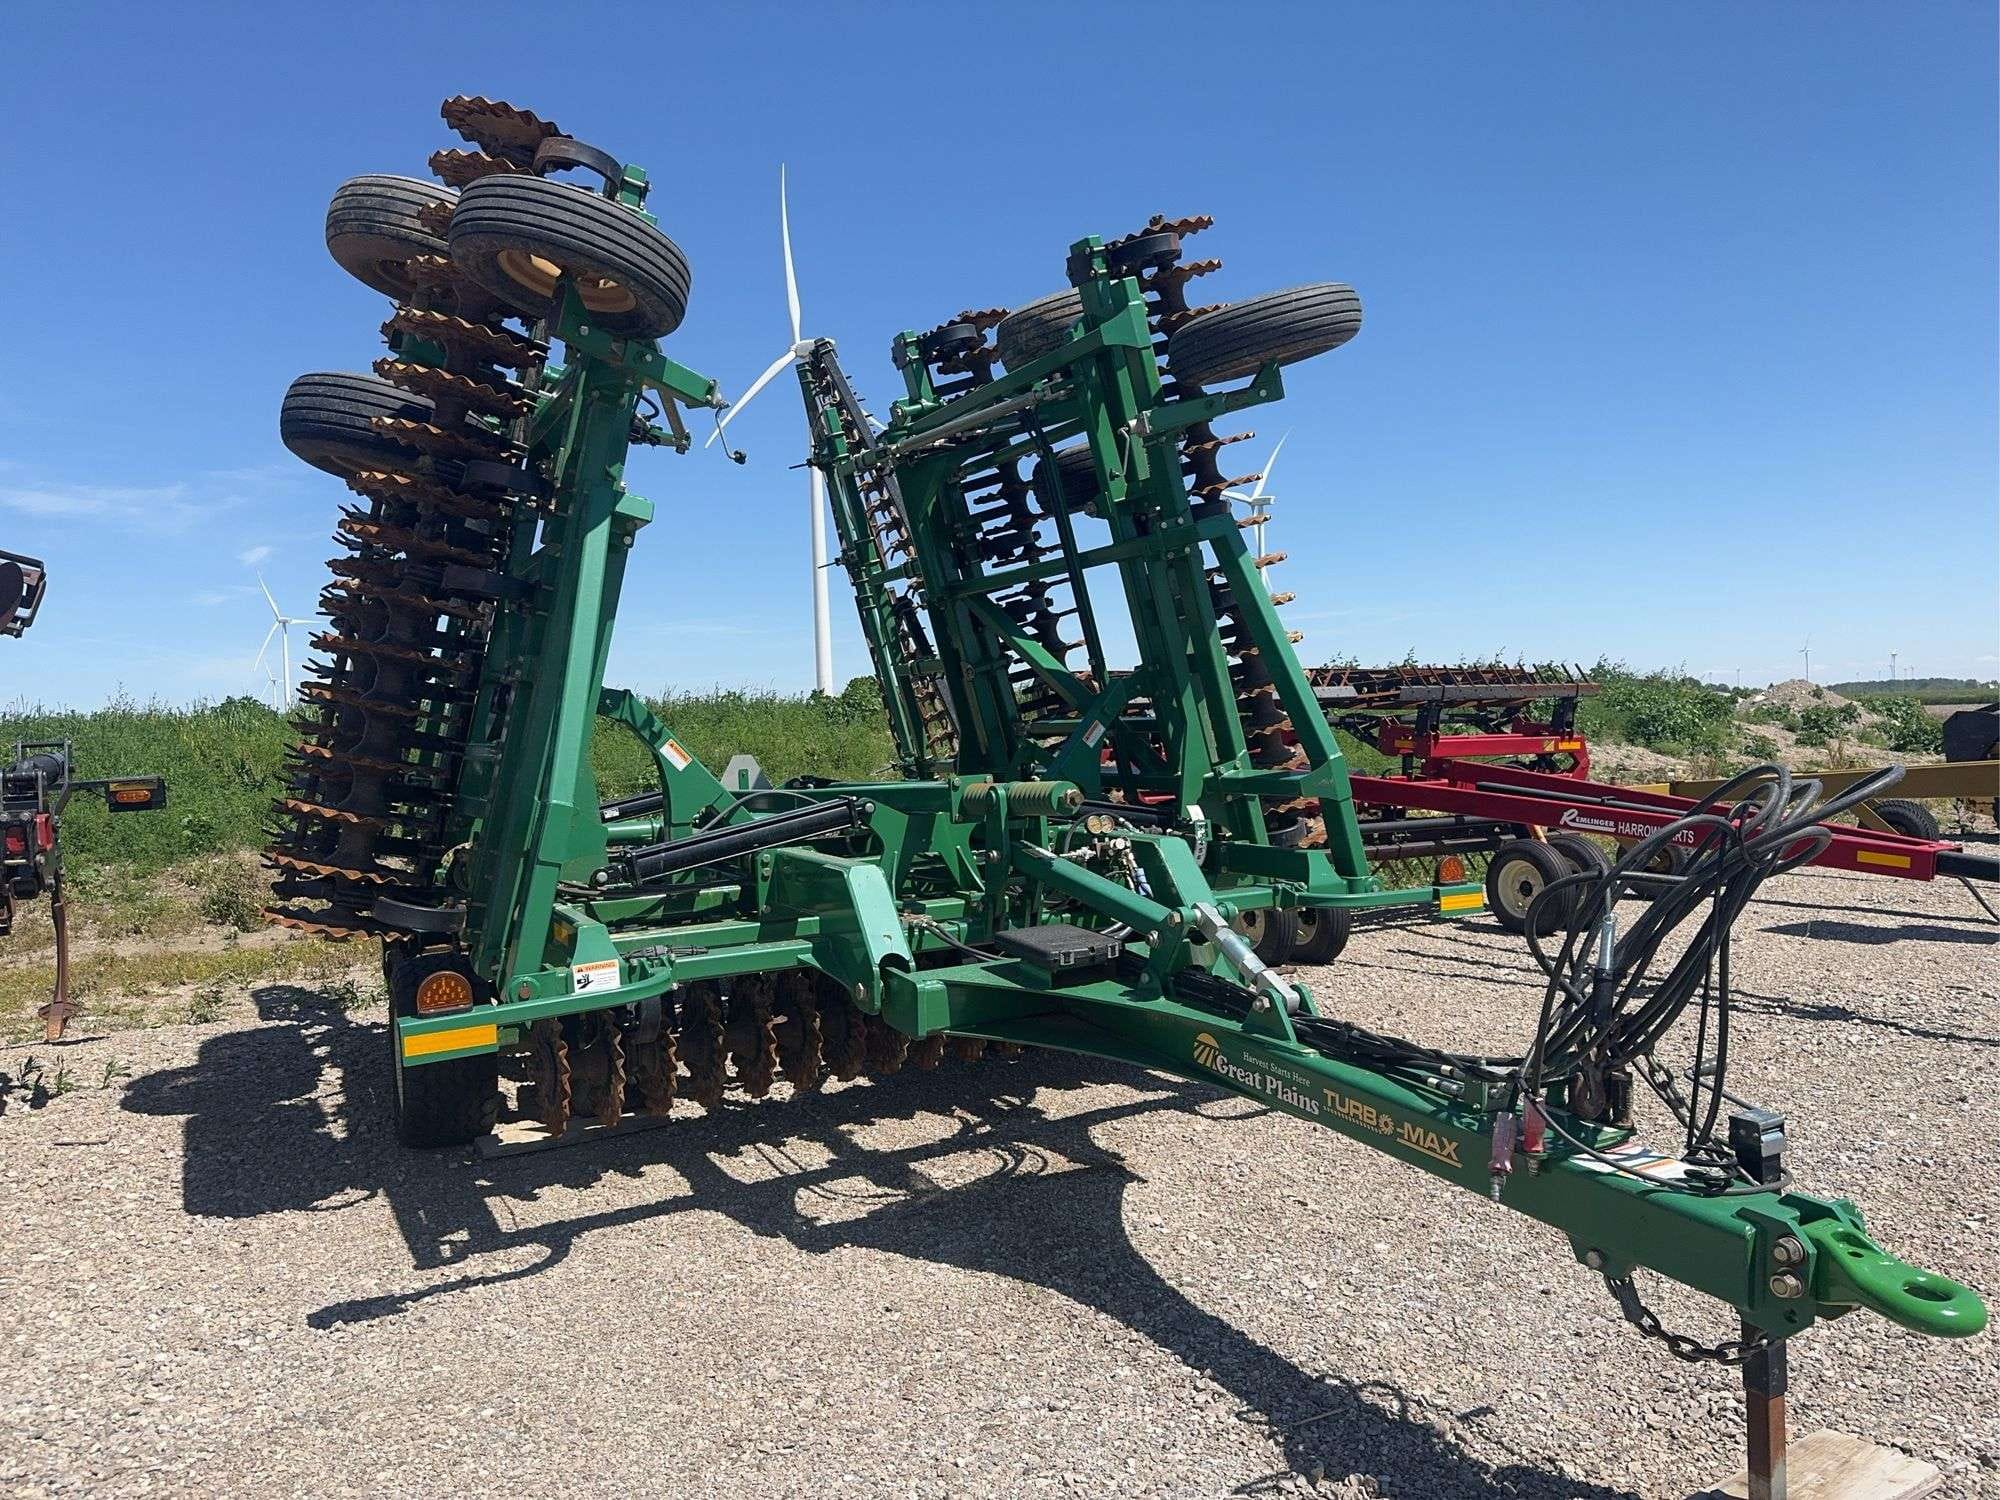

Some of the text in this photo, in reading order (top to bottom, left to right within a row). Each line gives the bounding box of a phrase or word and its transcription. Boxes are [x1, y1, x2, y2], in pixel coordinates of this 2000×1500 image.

[1560, 808, 1616, 833] REMLINGER
[1217, 1054, 1320, 1116] Great Plains
[1242, 1051, 1311, 1087] Harvest Starts Here
